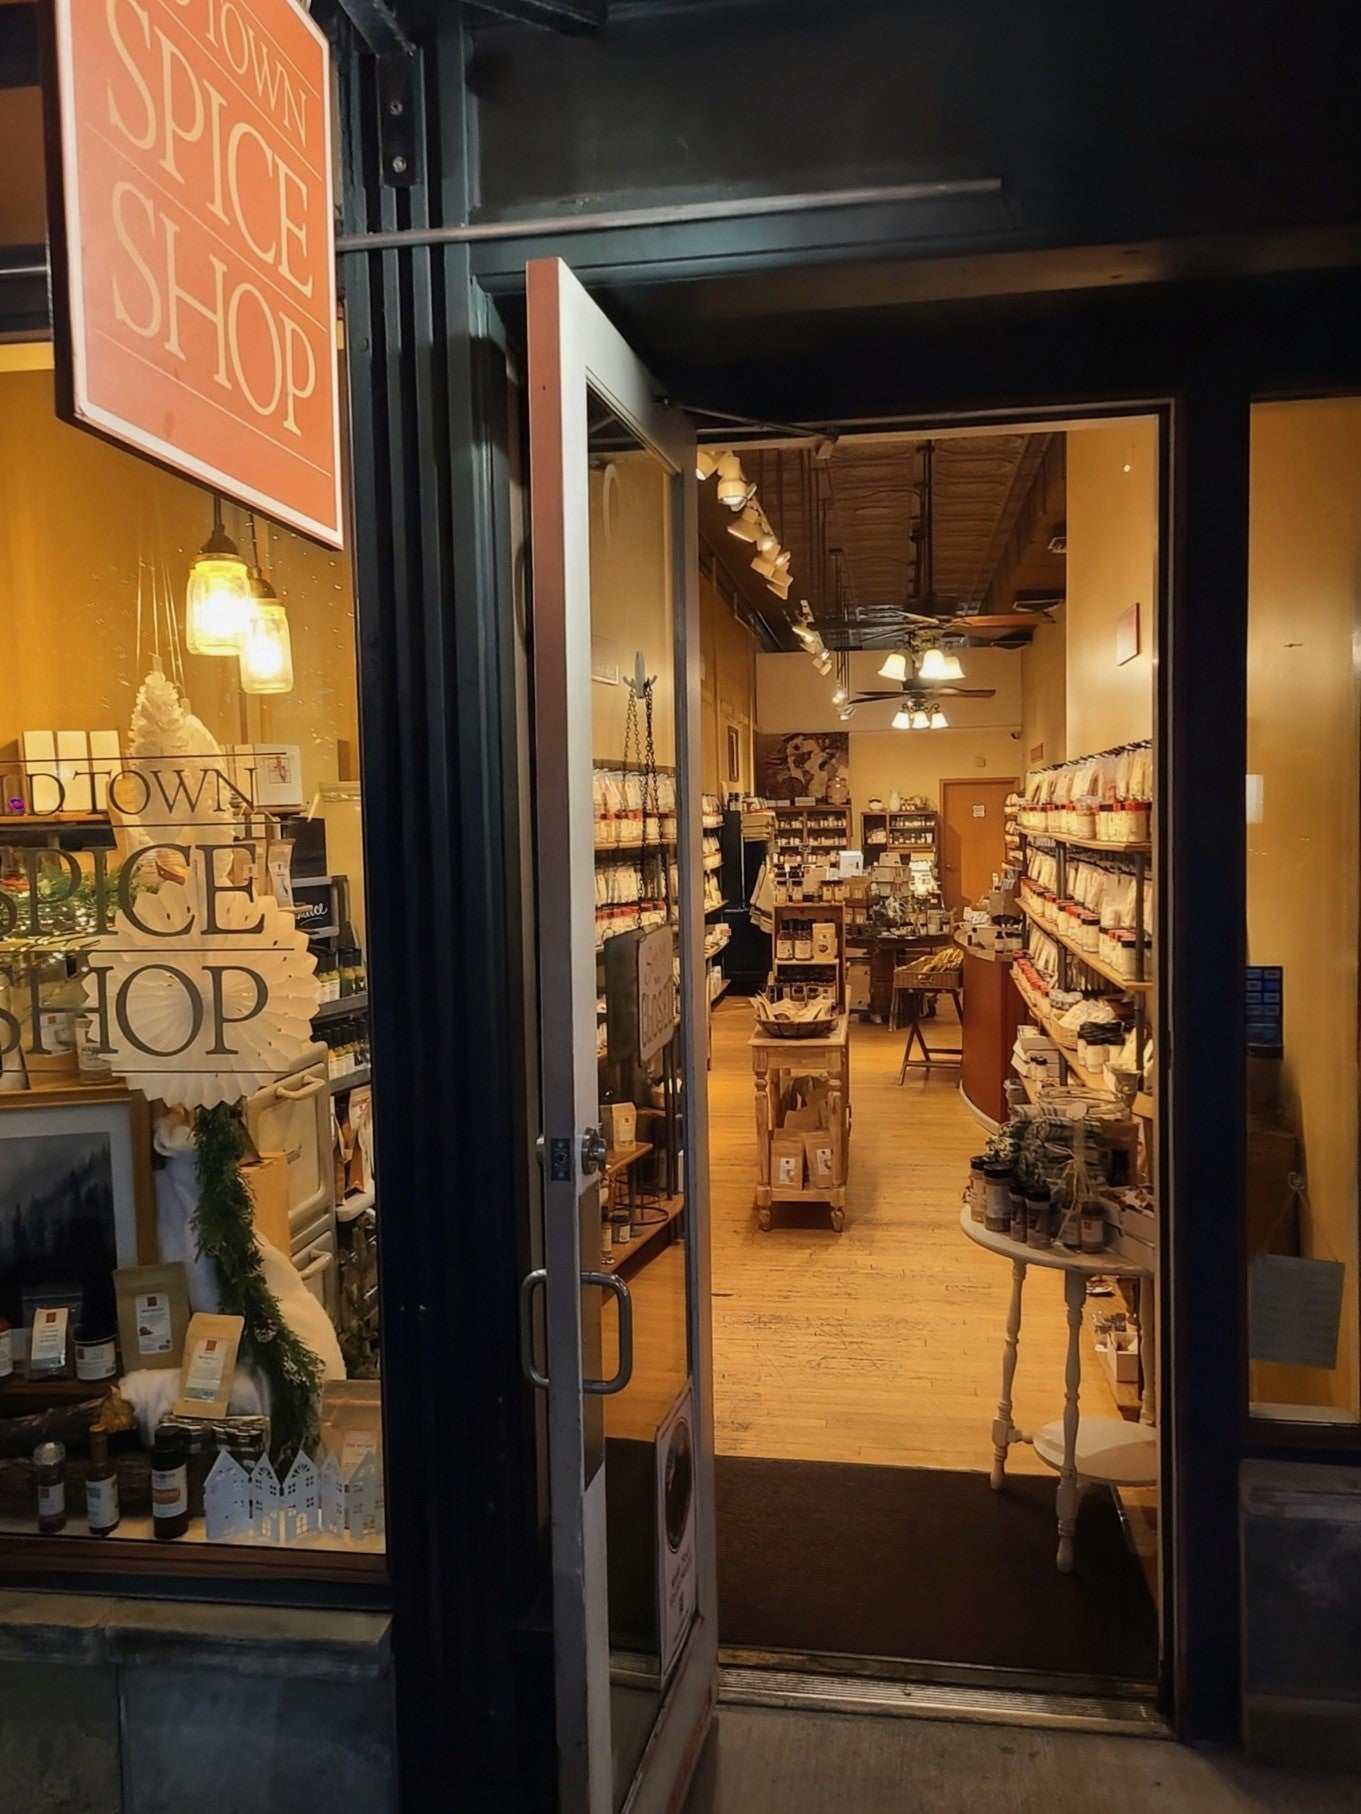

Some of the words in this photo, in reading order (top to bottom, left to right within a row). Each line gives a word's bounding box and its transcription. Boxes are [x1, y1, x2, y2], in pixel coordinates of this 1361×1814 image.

[106, 0, 313, 298] SPICE
[112, 181, 316, 437] SHOP
[73, 766, 257, 816] TOWN
